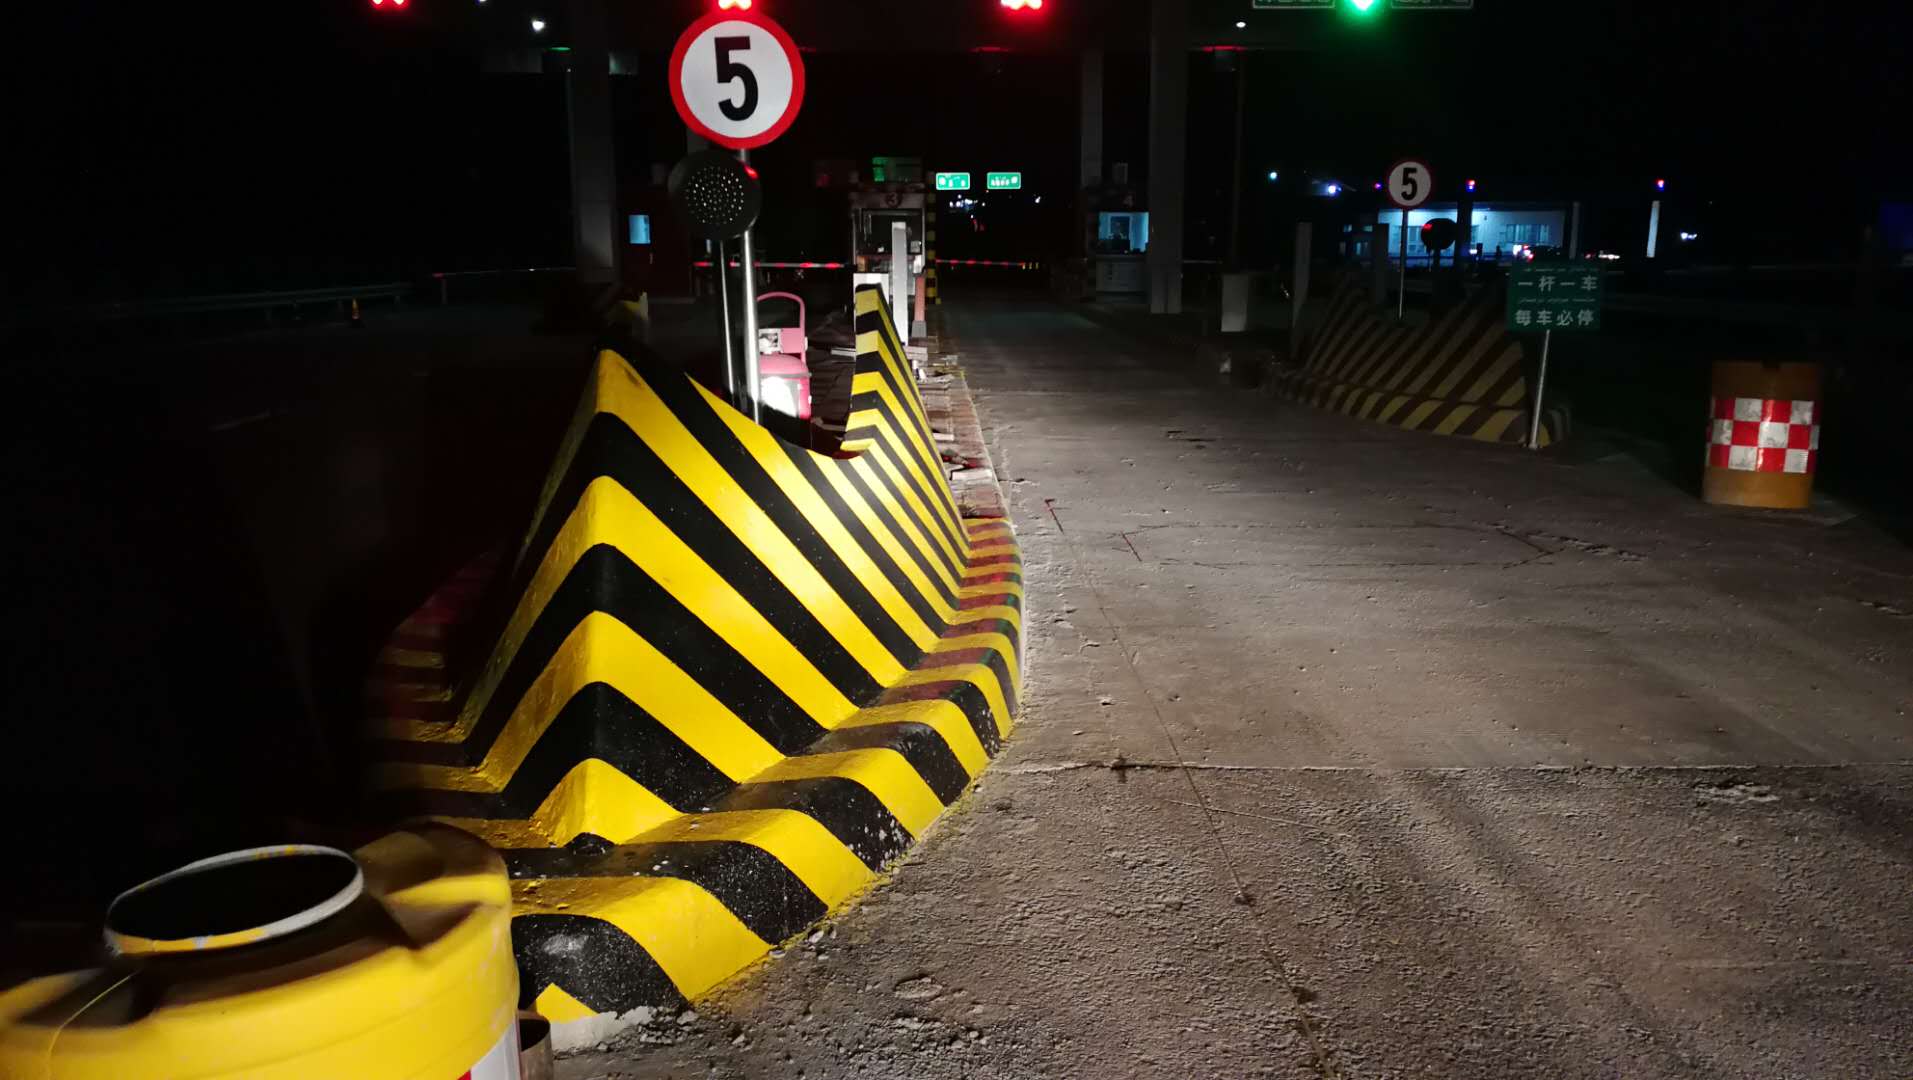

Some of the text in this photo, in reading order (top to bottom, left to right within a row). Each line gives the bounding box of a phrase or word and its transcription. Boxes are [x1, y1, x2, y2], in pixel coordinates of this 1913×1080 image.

[714, 36, 758, 121] 5
[1402, 167, 1417, 200] 5
[1517, 275, 1598, 291] 一杆一车
[1515, 309, 1594, 326] 每车必停
